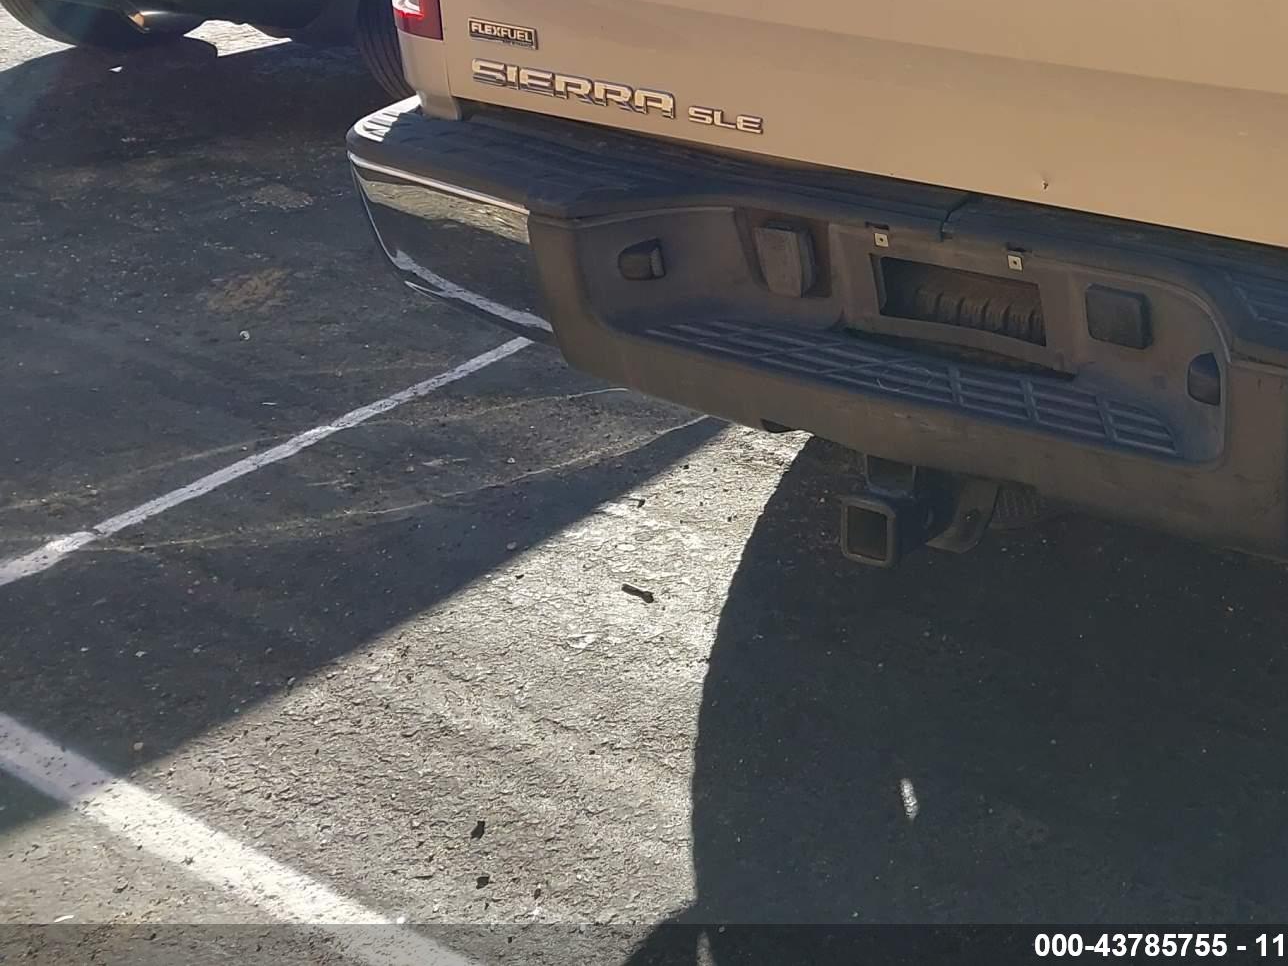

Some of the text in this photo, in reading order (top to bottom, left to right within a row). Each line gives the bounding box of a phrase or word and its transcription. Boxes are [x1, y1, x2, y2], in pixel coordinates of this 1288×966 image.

[470, 21, 533, 43] FLEXFUEL
[471, 58, 764, 134] SIERRA SLE
